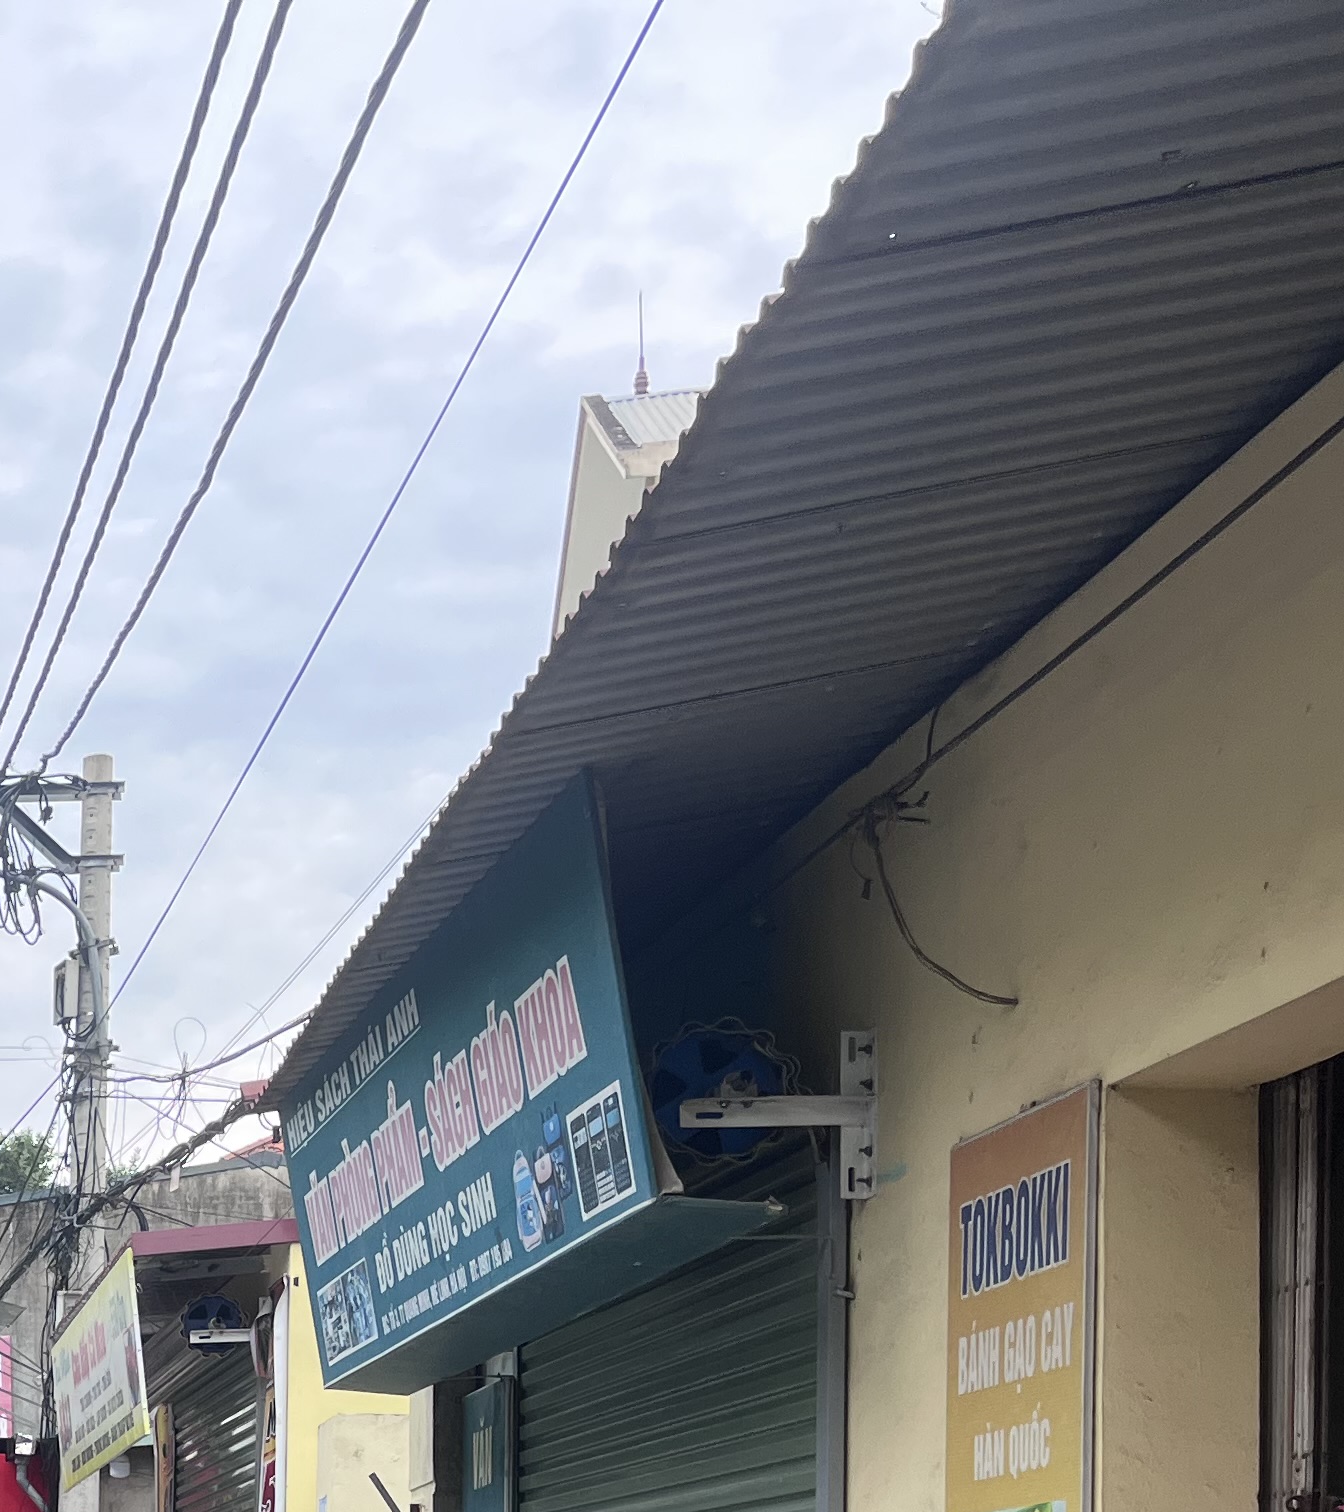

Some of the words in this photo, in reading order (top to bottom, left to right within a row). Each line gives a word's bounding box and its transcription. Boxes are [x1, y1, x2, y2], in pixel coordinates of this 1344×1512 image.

[316, 1060, 351, 1122] SÁCH
[350, 1024, 385, 1086] THÁI
[387, 988, 420, 1053] ANH
[328, 1137, 382, 1250] PHÒNG
[370, 1079, 424, 1217] PHẨM
[424, 1048, 481, 1172] SÁCH
[470, 999, 525, 1136] GIÁO
[513, 954, 588, 1101] KHOA
[374, 1231, 395, 1294] ĐỒ
[392, 1221, 431, 1282] DÙNG
[427, 1200, 459, 1262] HỌC
[457, 1171, 498, 1238] SINH
[959, 1158, 1072, 1300] TOKBOKKI
[958, 1319, 1000, 1396] BÁNH
[1004, 1314, 1036, 1394] GẠO
[1041, 1302, 1074, 1373] CAY
[472, 1416, 493, 1490] VĂN
[973, 1422, 1005, 1481] HÀN
[1009, 1401, 1051, 1480] QUỐC
